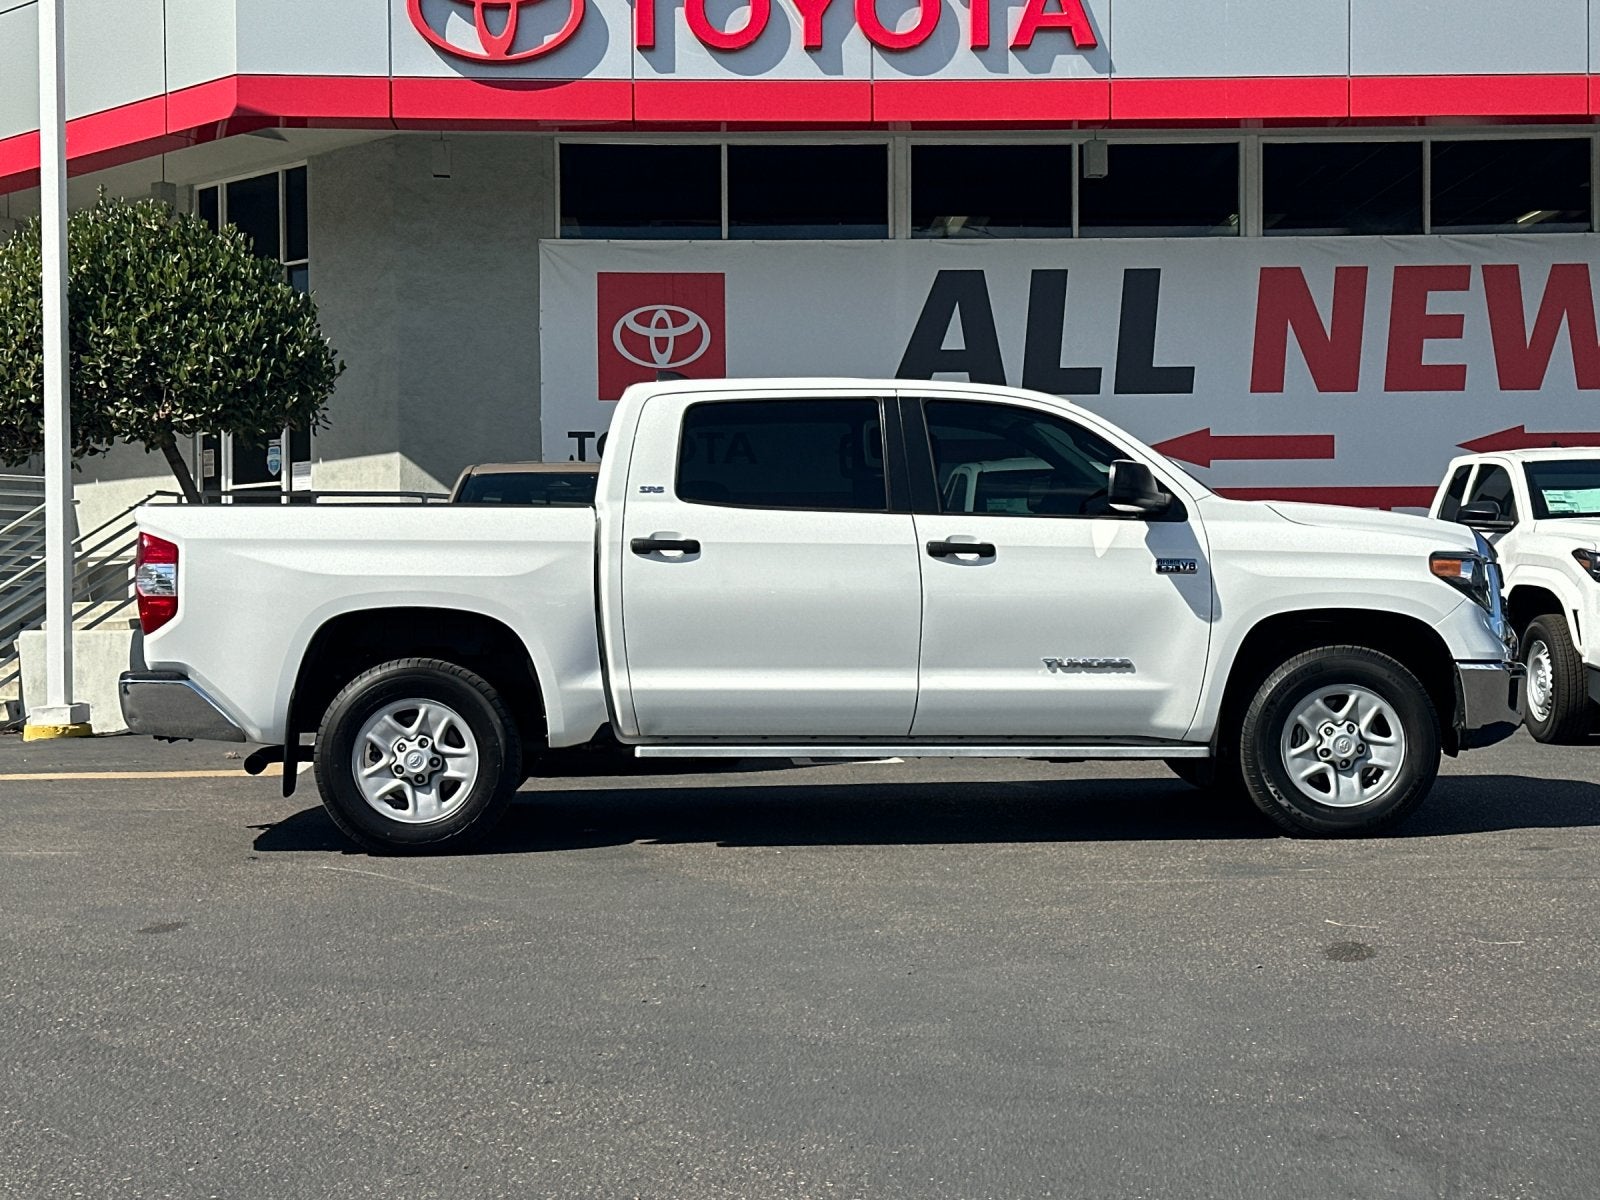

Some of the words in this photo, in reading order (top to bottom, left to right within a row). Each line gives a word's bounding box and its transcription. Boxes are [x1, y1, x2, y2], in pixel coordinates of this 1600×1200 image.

[894, 268, 1196, 394] ALL
[1250, 263, 1600, 393] NEW
[1181, 561, 1196, 571] V8
